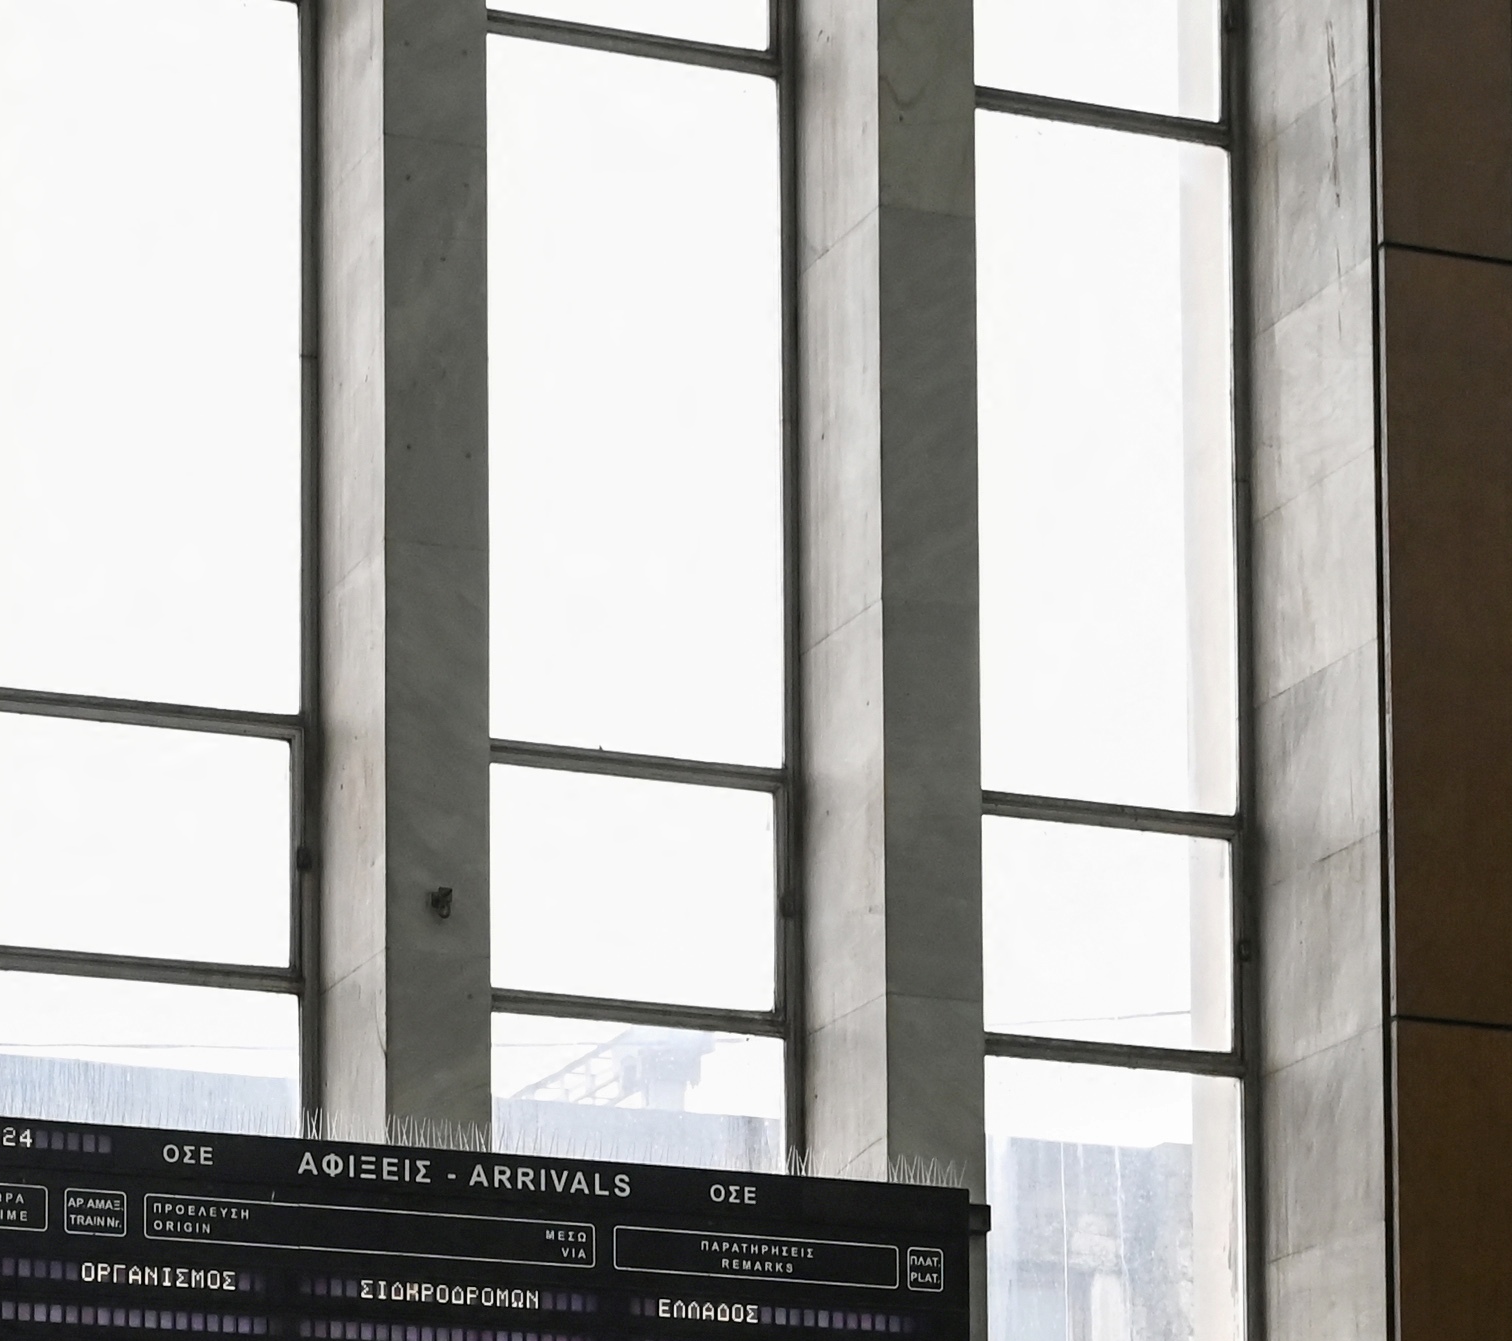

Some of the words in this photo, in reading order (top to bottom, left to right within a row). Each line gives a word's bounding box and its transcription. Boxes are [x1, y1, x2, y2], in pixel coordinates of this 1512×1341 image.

[163, 1144, 213, 1165] ΟΣΕ
[297, 1151, 431, 1183] ΑΦΙΞΕΙΣ
[469, 1164, 631, 1197] ARRIVALS
[710, 1184, 756, 1205] ΟΣΕ
[153, 1202, 249, 1220] ΠΡΟΕΛΕΥΣΗ
[69, 1214, 105, 1227] TRAIN
[153, 1220, 210, 1234] ORIGIN
[545, 1229, 587, 1243] ΜΕΣΩ
[561, 1247, 586, 1259] VIA
[700, 1240, 814, 1259] ΠΑΡΑΤΗΡΗΣΕΙΣ
[721, 1258, 793, 1274] REMARKS
[910, 1271, 938, 1284] PLAT.
[81, 1262, 236, 1291] ΟΡΓΑΝΙΣΜΟΣ
[658, 1298, 759, 1324] ΕΛΛΑΔΟΣ
